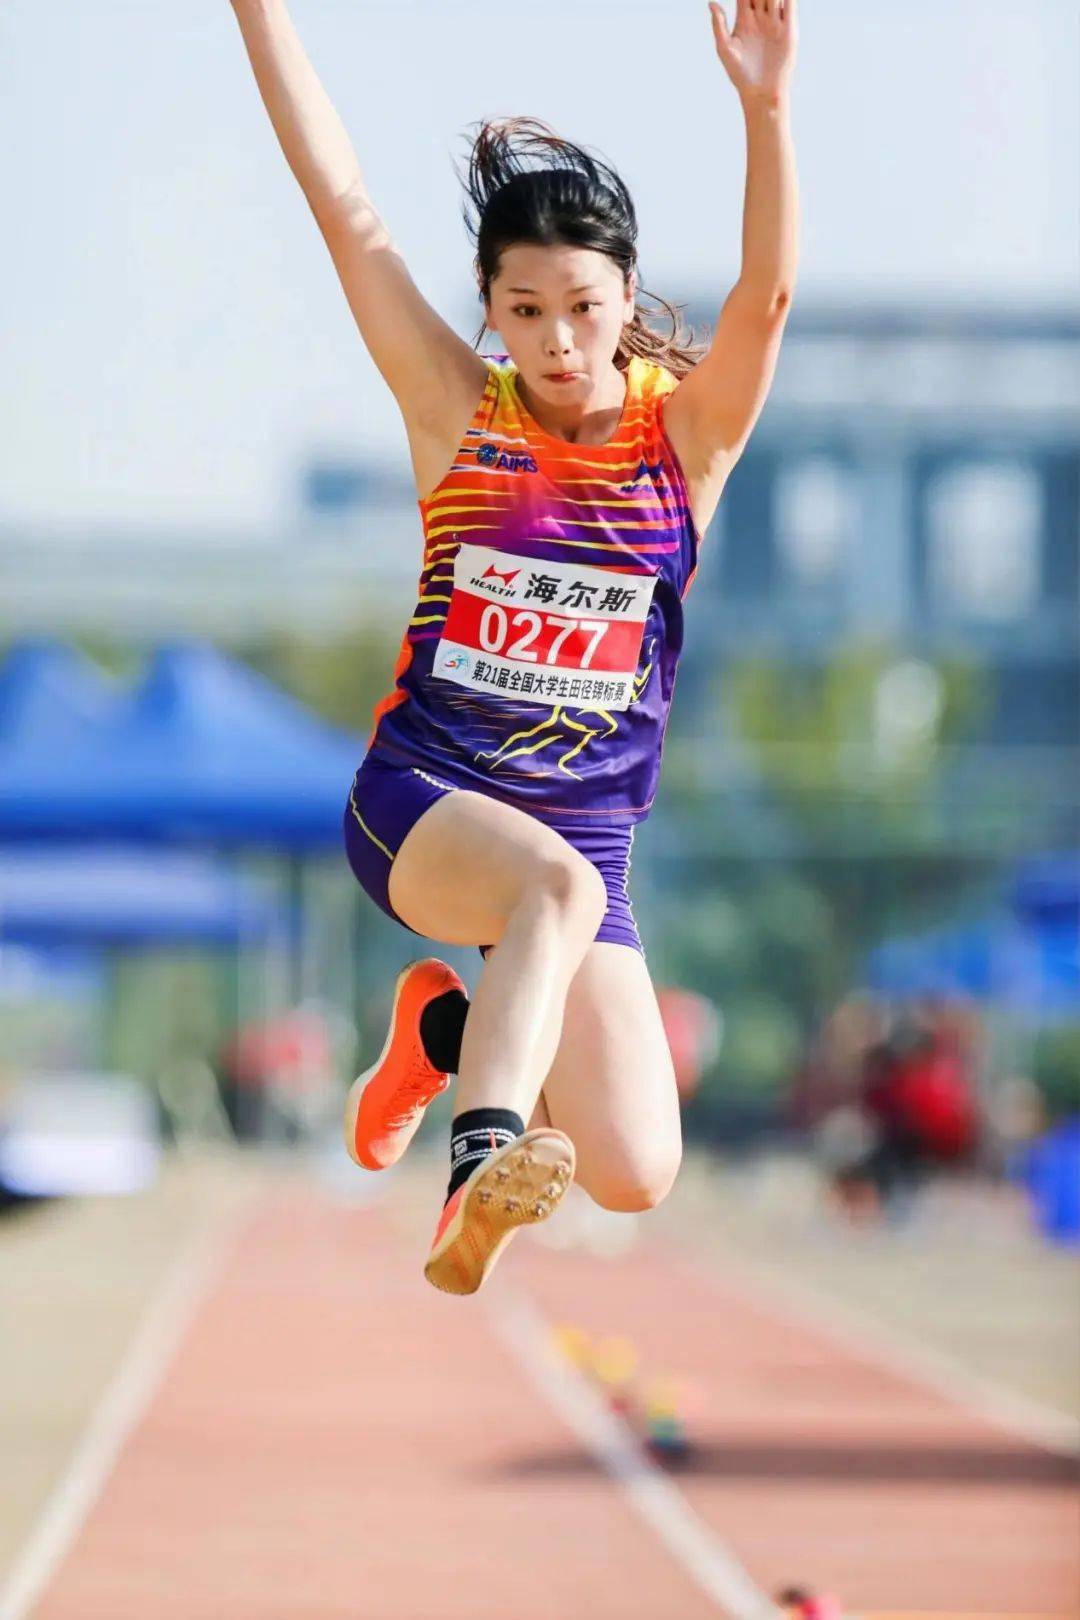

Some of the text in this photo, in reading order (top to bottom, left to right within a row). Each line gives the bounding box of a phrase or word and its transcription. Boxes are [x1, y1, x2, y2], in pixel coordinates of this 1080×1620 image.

[496, 453, 538, 473] AIMS
[470, 577, 516, 598] HEALTH
[524, 573, 636, 612] 海尔斯
[479, 605, 609, 668] 0277
[472, 660, 627, 701] 第21届全国大学生田径锦标赛
